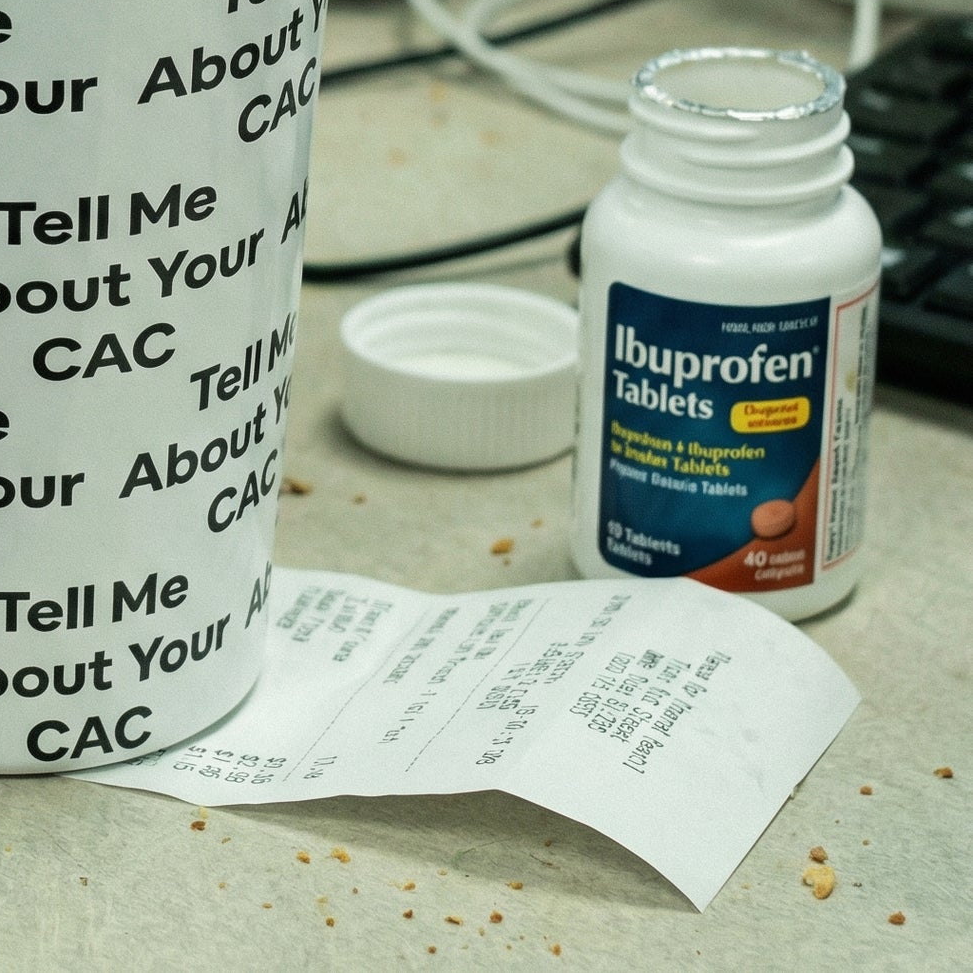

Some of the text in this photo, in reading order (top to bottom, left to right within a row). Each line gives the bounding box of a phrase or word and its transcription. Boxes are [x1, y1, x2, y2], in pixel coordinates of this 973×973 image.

[137, 7, 304, 105] About
[237, 56, 317, 143] CAC
[129, 183, 217, 236] Me
[147, 227, 265, 298] Your
[32, 322, 176, 382] CAC
[189, 338, 263, 412] Tell
[611, 367, 715, 420] Tablets
[117, 402, 267, 499] About
[206, 448, 278, 533] CAC
[111, 572, 189, 623] Me
[128, 613, 231, 682] Your
[26, 705, 153, 763] CAC
